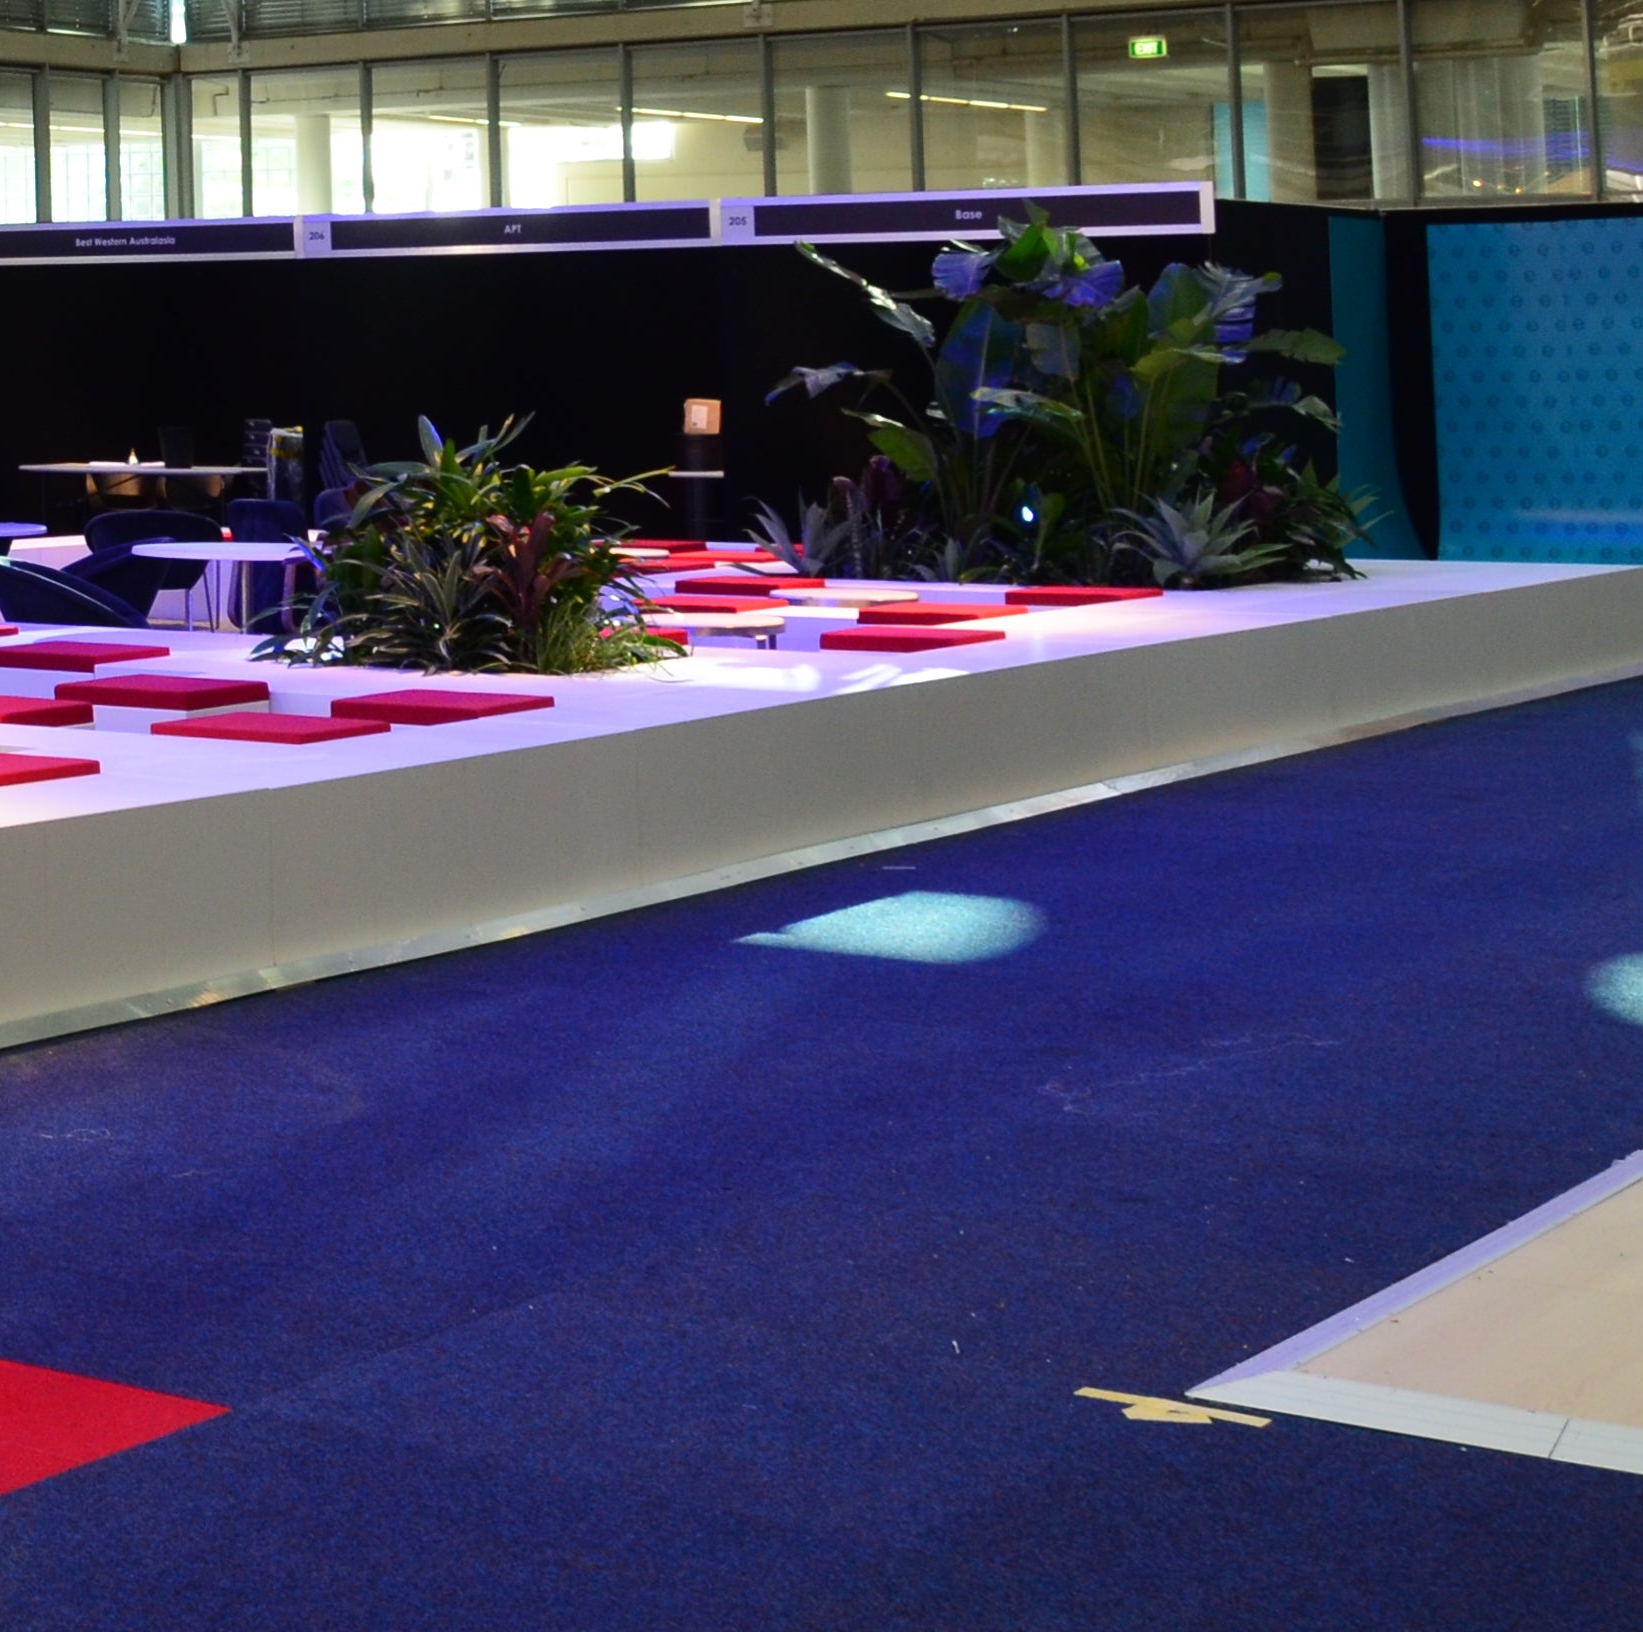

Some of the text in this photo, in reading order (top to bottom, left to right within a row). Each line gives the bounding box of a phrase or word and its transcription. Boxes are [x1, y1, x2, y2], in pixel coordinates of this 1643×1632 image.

[955, 209, 983, 220] Base
[504, 224, 523, 234] APT
[75, 235, 176, 247] Best Western Australasia
